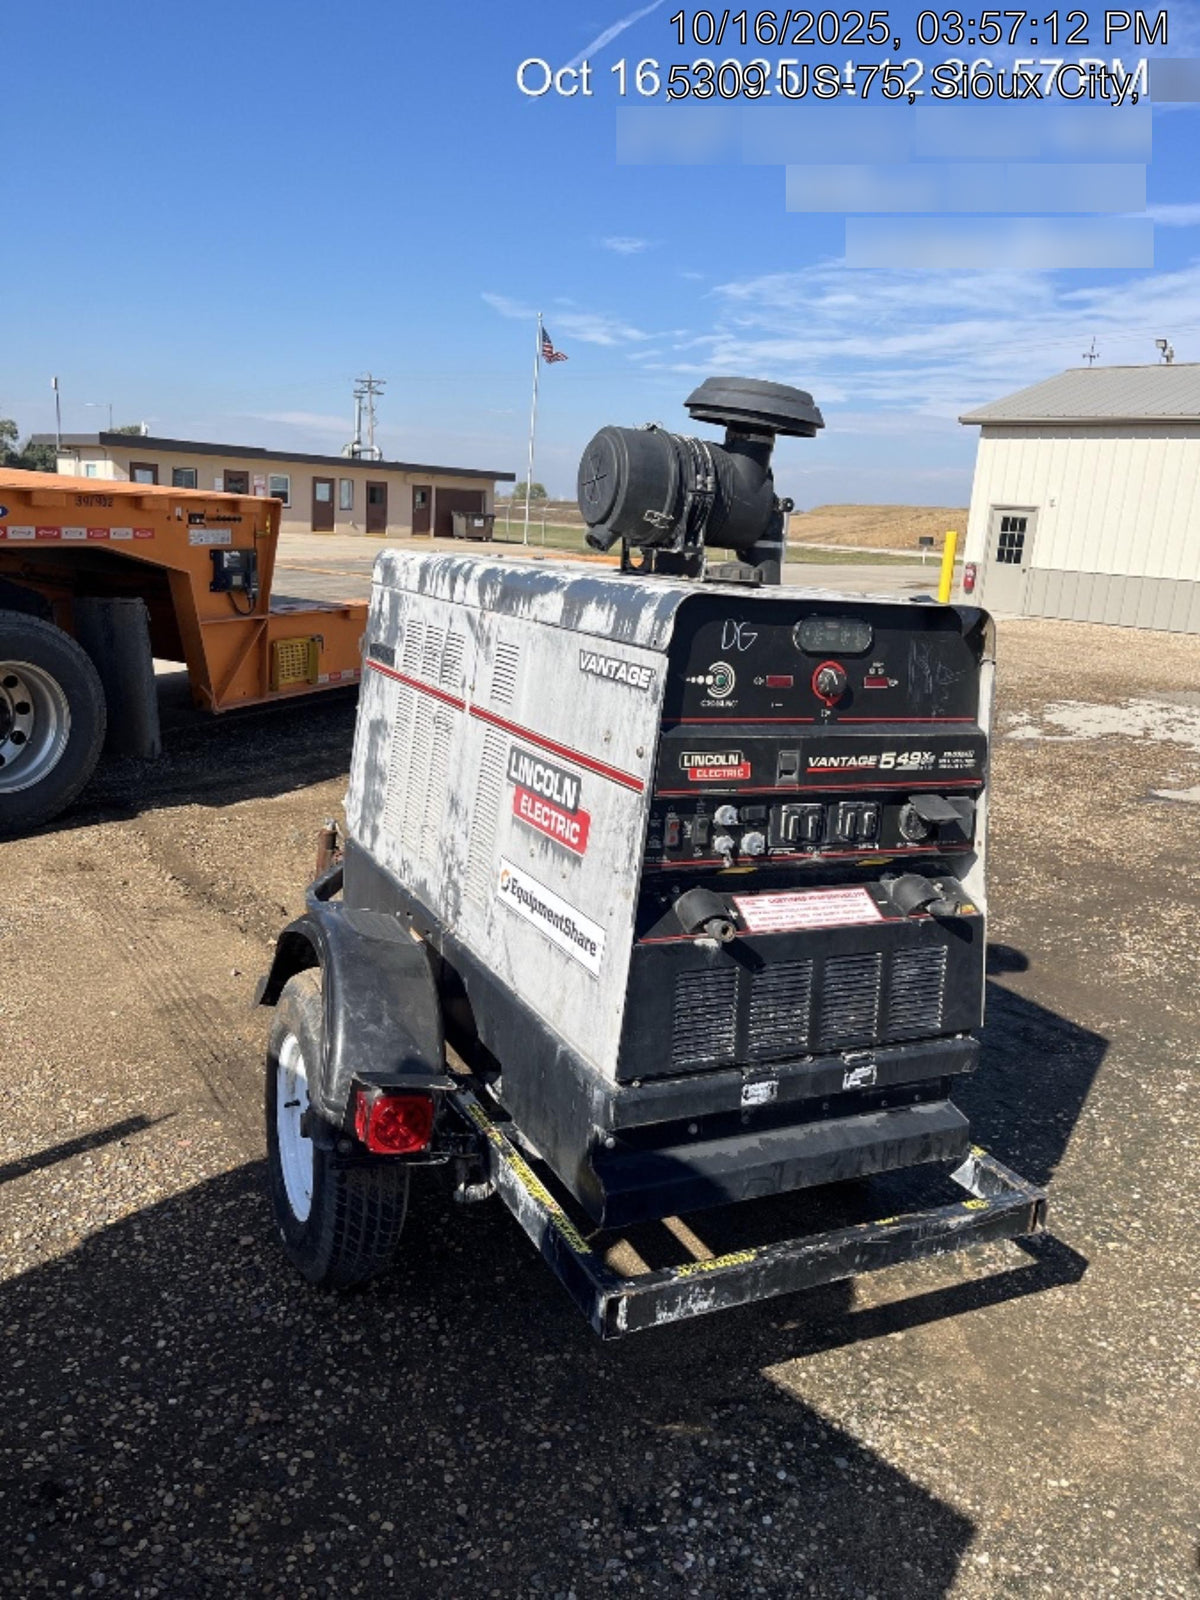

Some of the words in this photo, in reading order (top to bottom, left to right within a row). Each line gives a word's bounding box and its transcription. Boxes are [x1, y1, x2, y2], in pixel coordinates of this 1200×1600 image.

[579, 650, 654, 689] VANTAGE
[683, 753, 739, 767] LINCOLN
[696, 768, 744, 778] ELECTRIC
[808, 755, 878, 768] VANTAGE
[510, 751, 578, 810] LINCOLN
[519, 796, 582, 845] ELECTRIC
[510, 877, 597, 957] EquipmentShare
